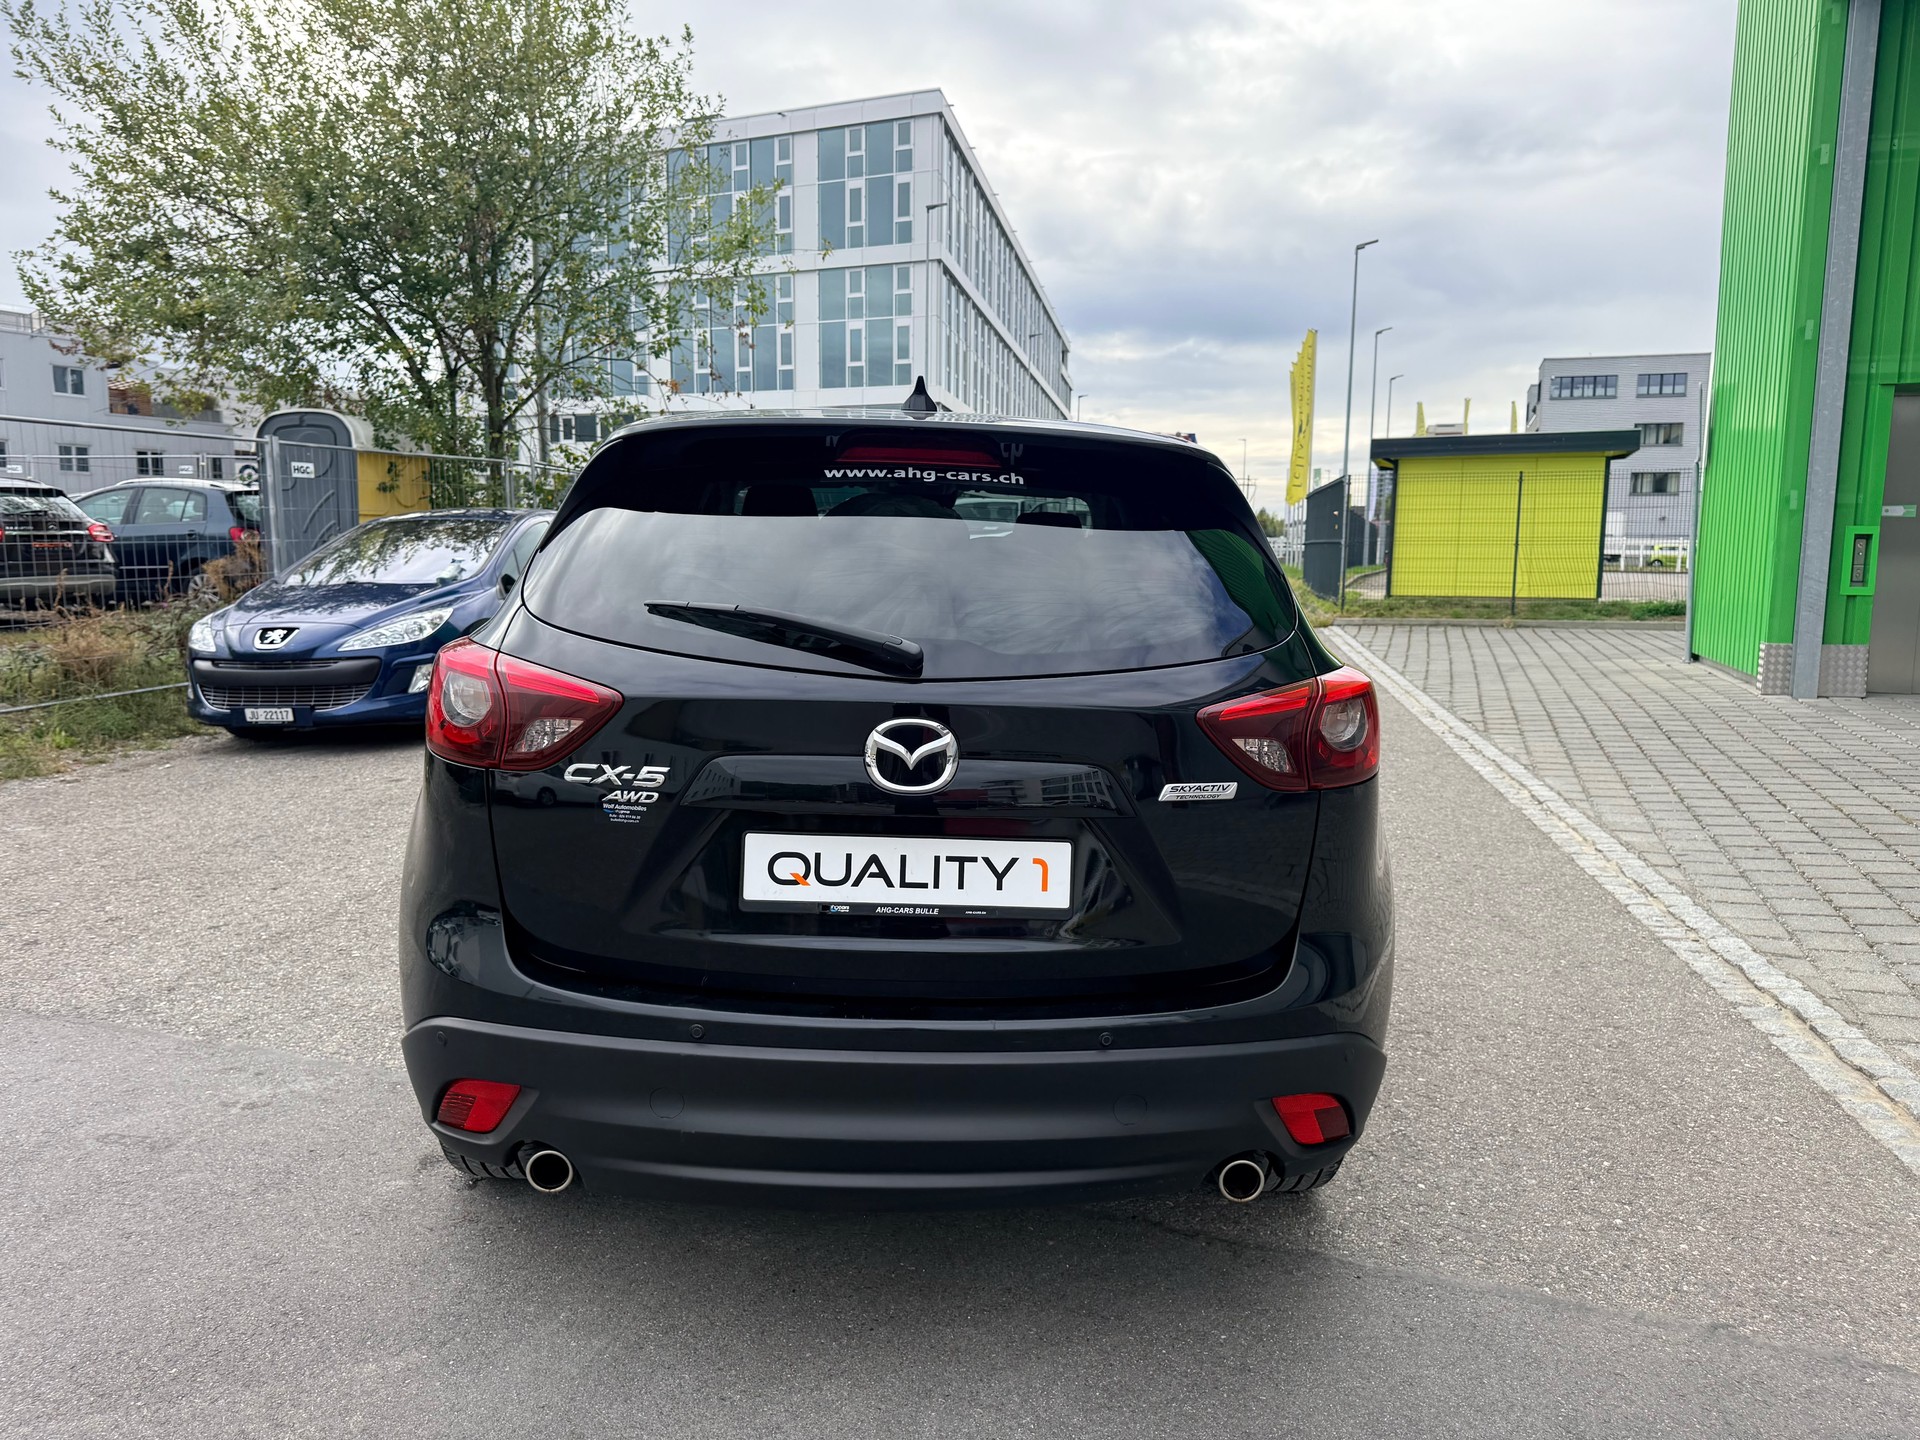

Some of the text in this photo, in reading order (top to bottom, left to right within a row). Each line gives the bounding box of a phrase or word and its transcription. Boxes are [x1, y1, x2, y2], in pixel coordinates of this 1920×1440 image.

[823, 466, 1025, 486] www.ahg-cars.ch
[563, 763, 671, 788] CX-5
[1169, 784, 1231, 793] SKYACTIV
[601, 790, 659, 803] AWD
[614, 804, 647, 812] Automobiles
[767, 851, 1020, 891] QUALITY
[875, 906, 940, 915] AHG-CARS BULLE
